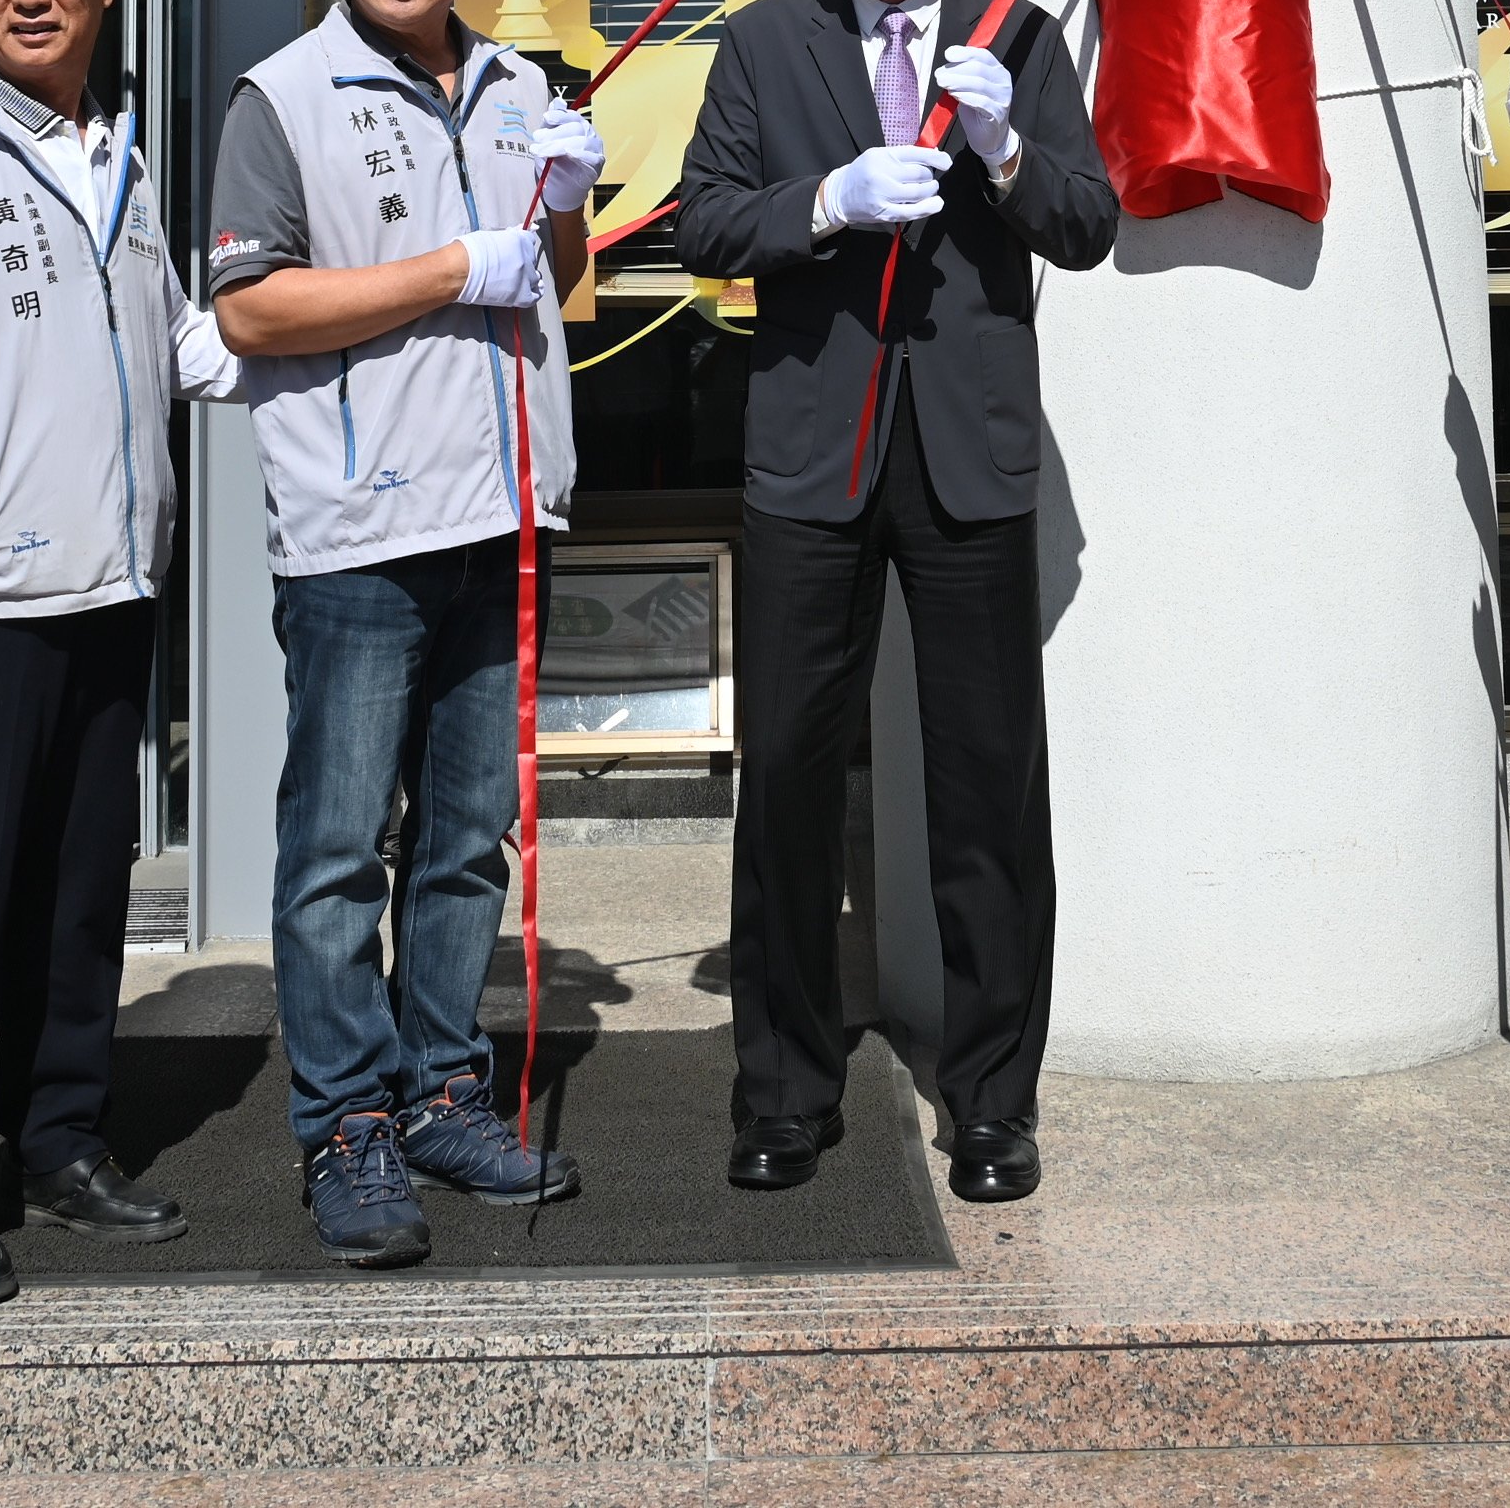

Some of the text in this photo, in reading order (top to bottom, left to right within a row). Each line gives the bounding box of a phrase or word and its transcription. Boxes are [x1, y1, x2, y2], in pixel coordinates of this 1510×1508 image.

[349, 106, 410, 224] 林宏義
[381, 102, 416, 171] 民政處處長
[22, 192, 59, 285] 農業處副處長
